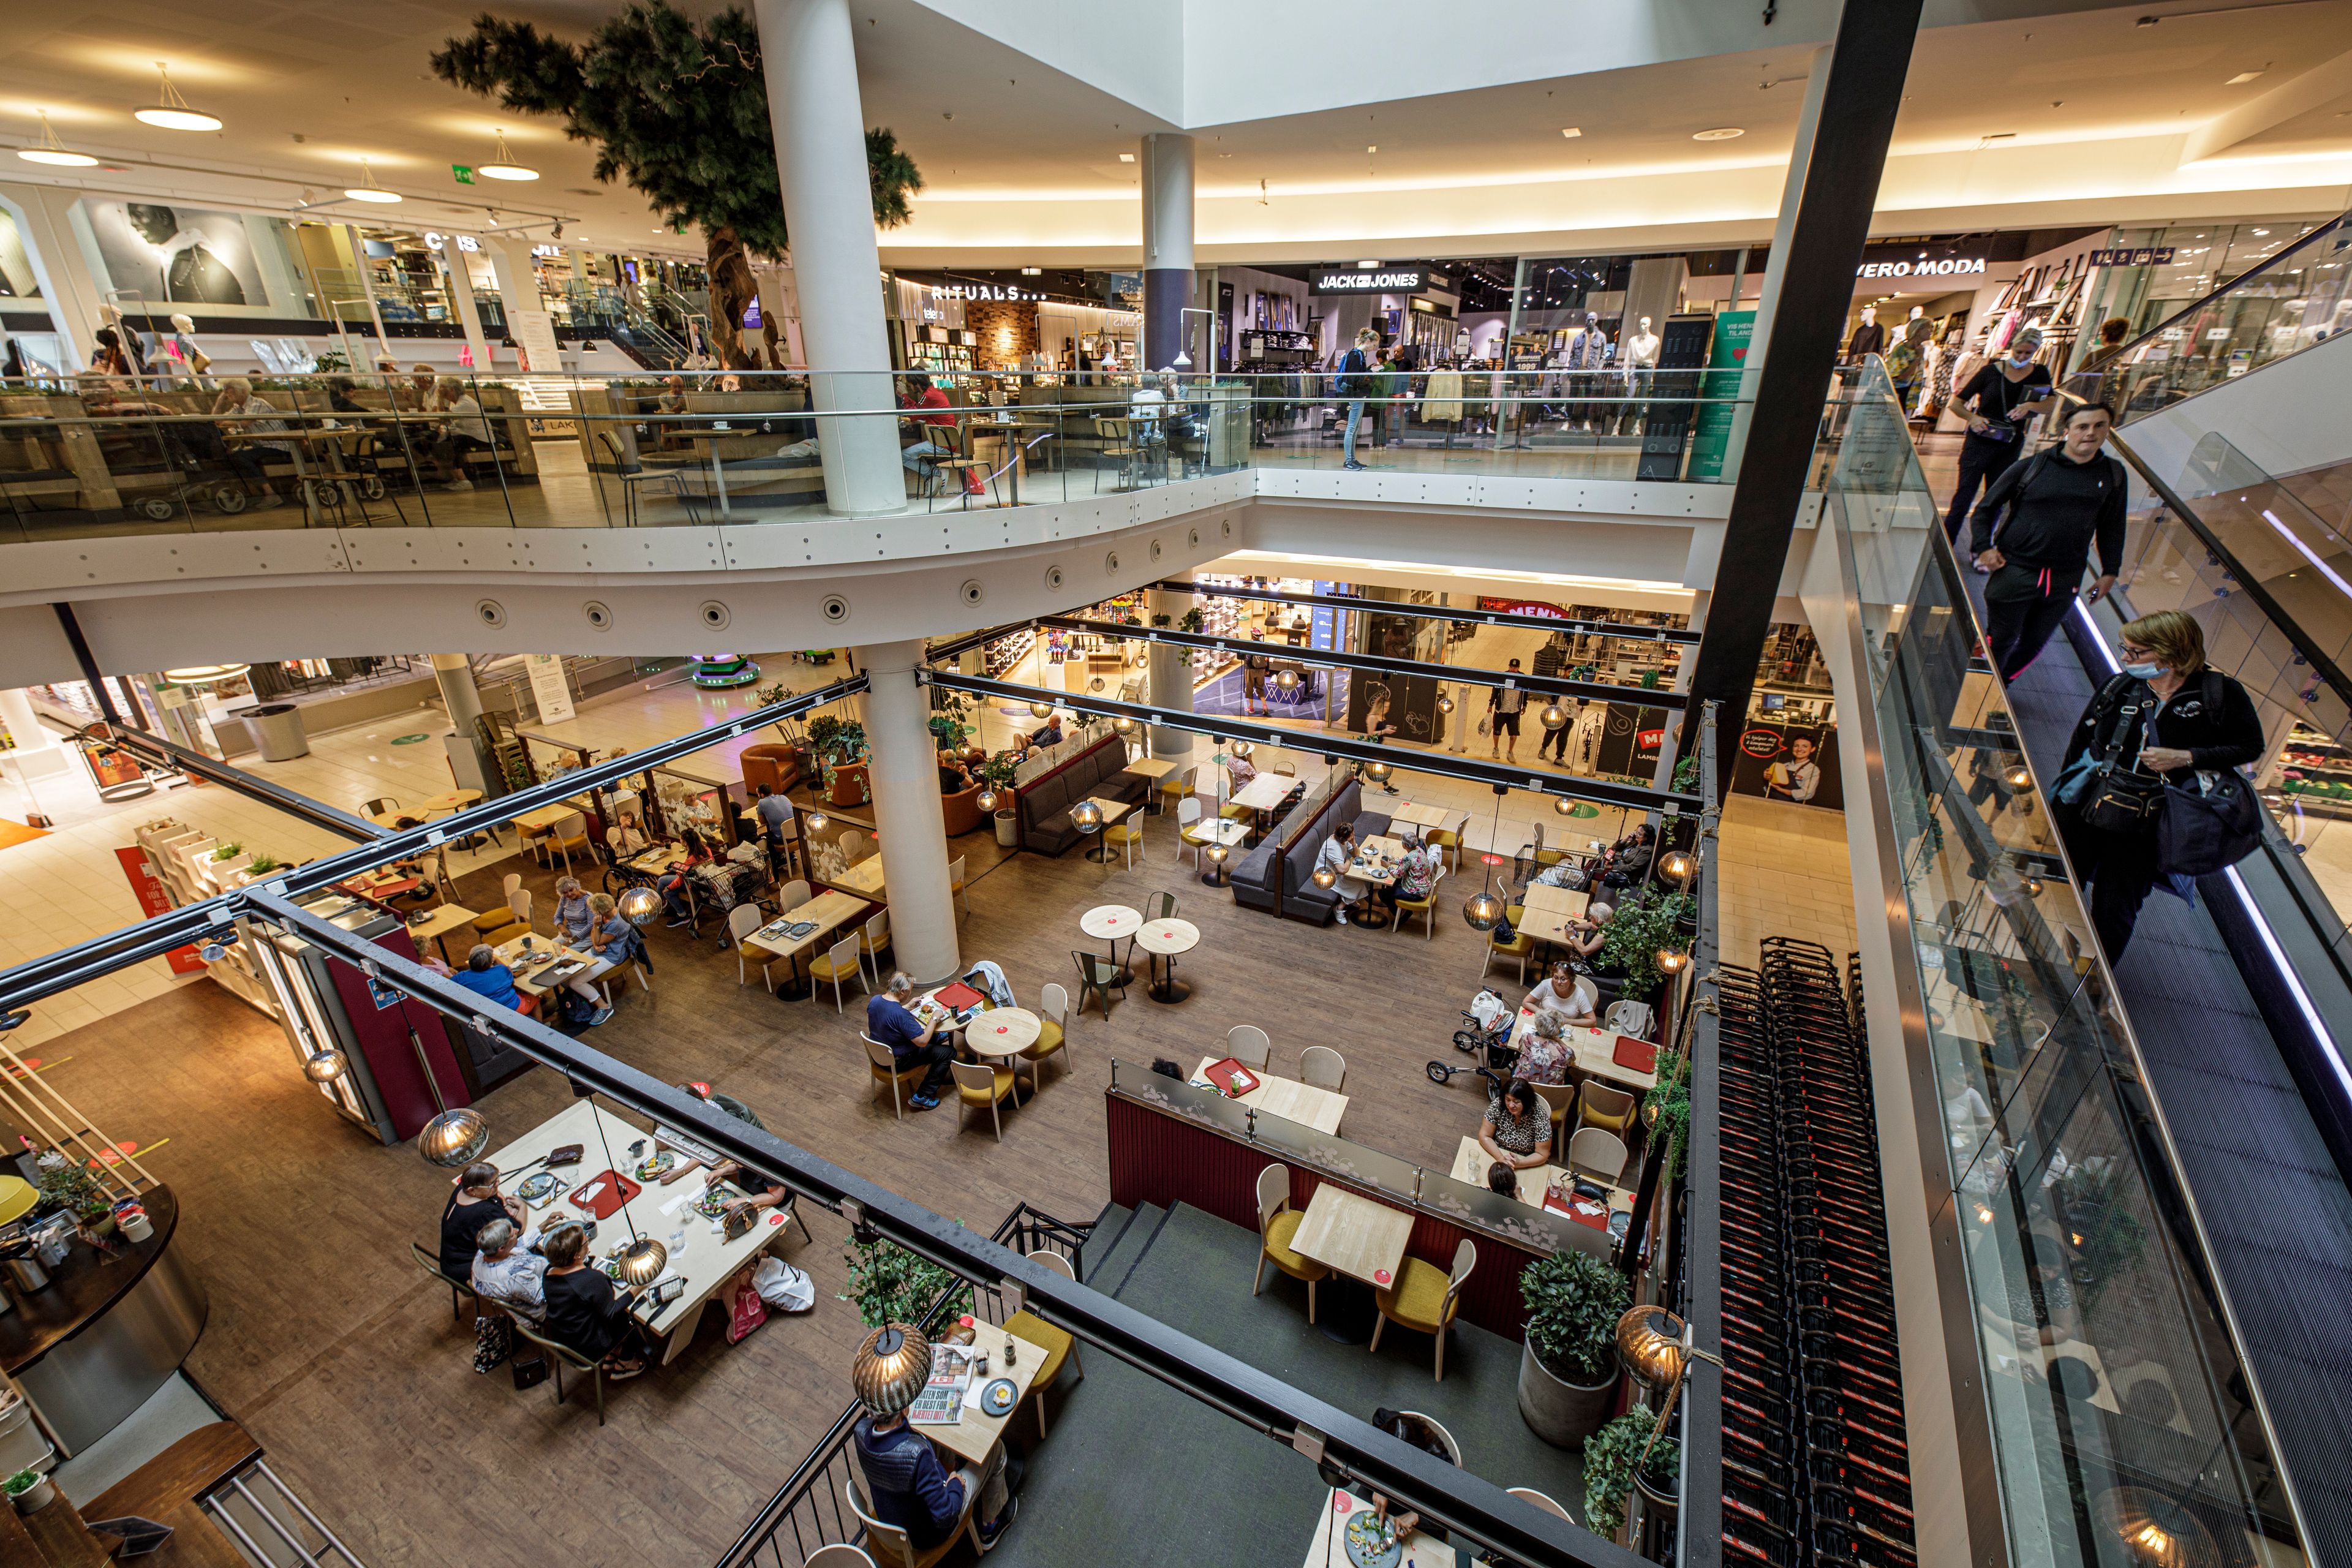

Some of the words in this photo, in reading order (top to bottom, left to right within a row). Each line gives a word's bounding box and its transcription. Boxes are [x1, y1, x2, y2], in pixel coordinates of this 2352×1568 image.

[1913, 258, 1986, 276] MODA
[1319, 275, 1357, 288] JACK
[1371, 273, 1419, 287] JONES
[931, 286, 1047, 300] RITUALS...
[1509, 606, 1562, 619] MENY
[147, 891, 161, 900] FOR
[936, 1390, 949, 1400] SOM
[914, 1400, 923, 1409] ER
[922, 1400, 937, 1409] BEST
[936, 1400, 948, 1410] FOR
[911, 1410, 934, 1420] HJERTET
[933, 1411, 946, 1420] DITT
